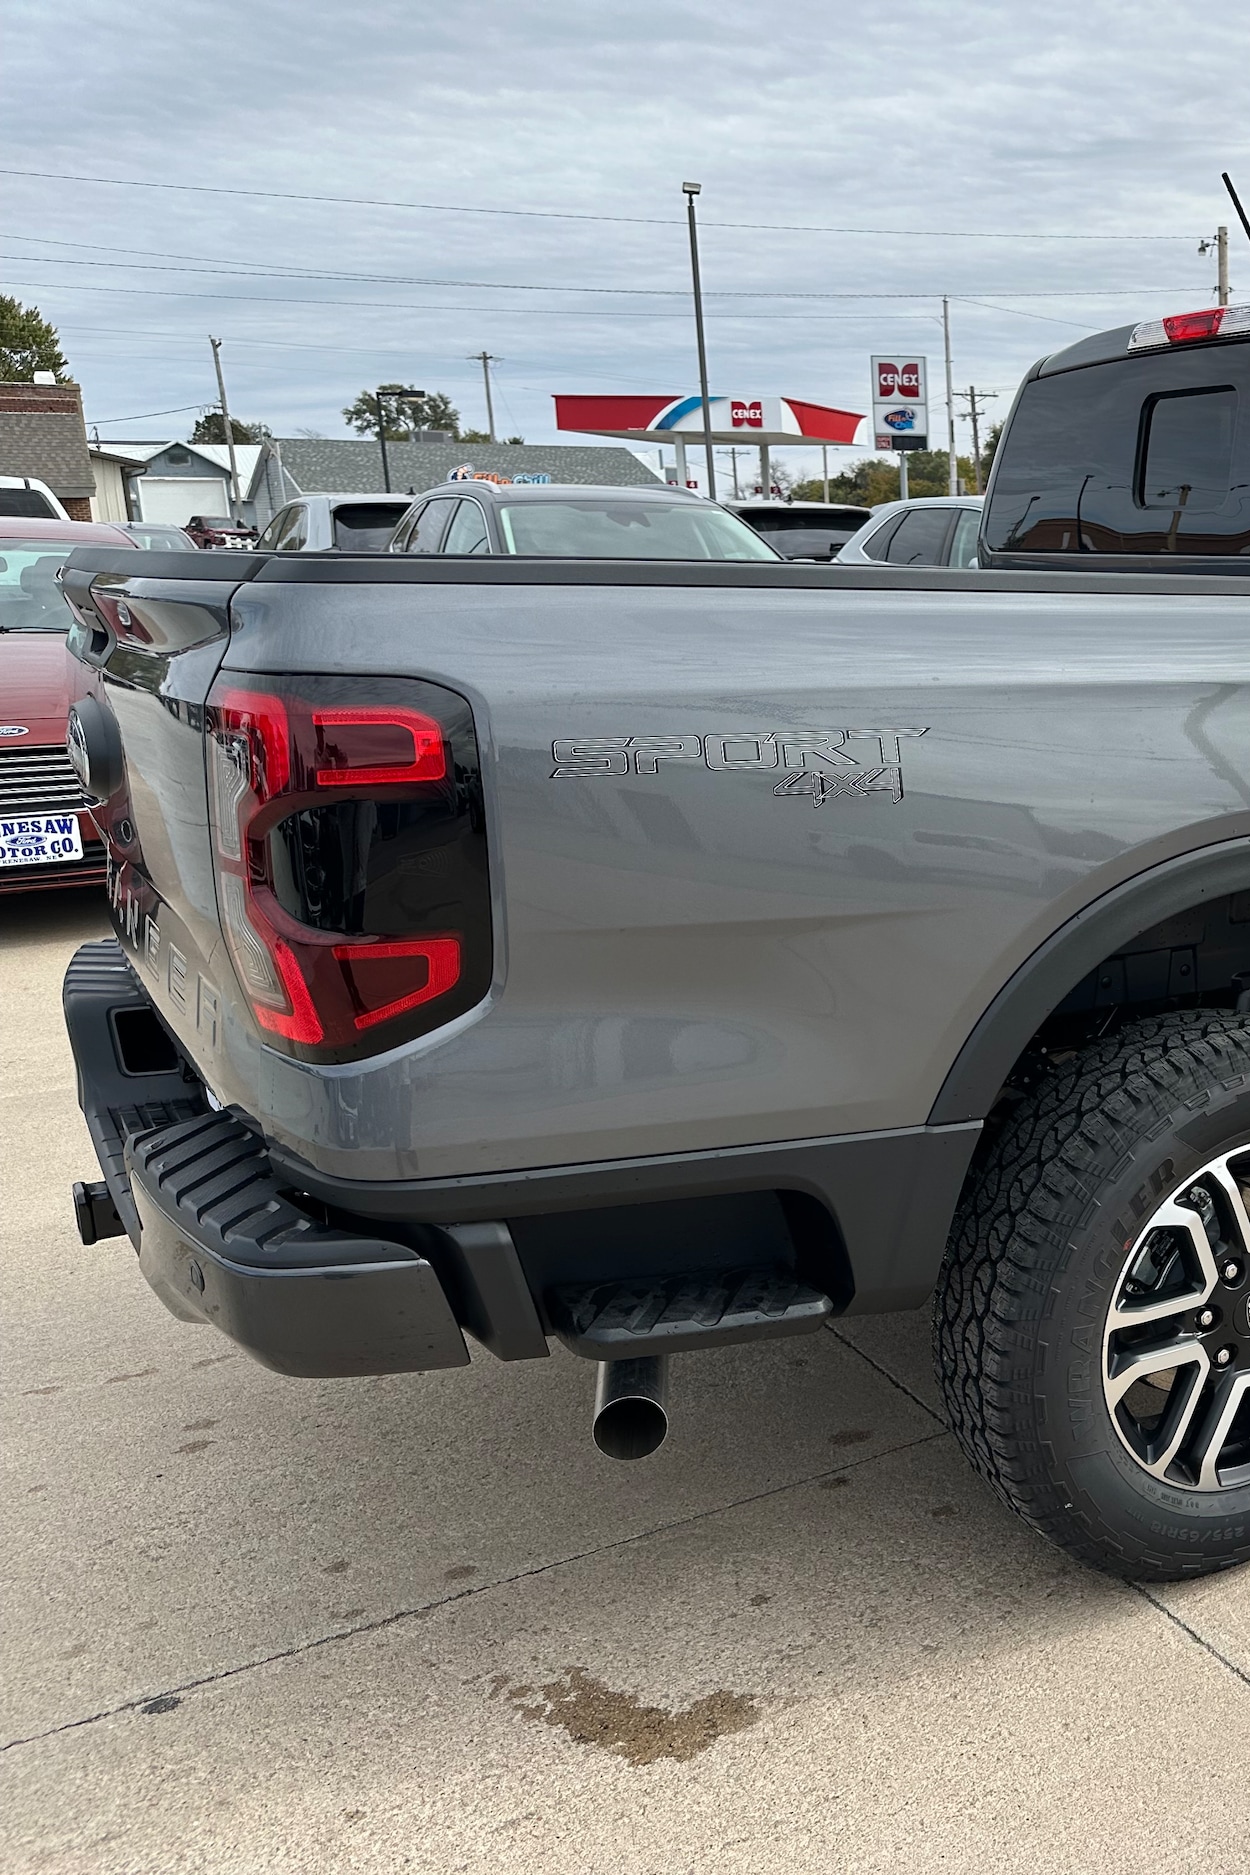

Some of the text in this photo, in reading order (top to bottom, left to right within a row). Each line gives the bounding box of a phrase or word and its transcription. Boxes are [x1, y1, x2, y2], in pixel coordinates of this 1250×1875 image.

[880, 374, 917, 386] CENEX
[732, 409, 761, 419] CENEX
[549, 727, 931, 779] SPORT
[50, 837, 79, 854] CO.
[1068, 1158, 1177, 1441] WRANGLER
[1149, 1520, 1245, 1543] 255/65R18
